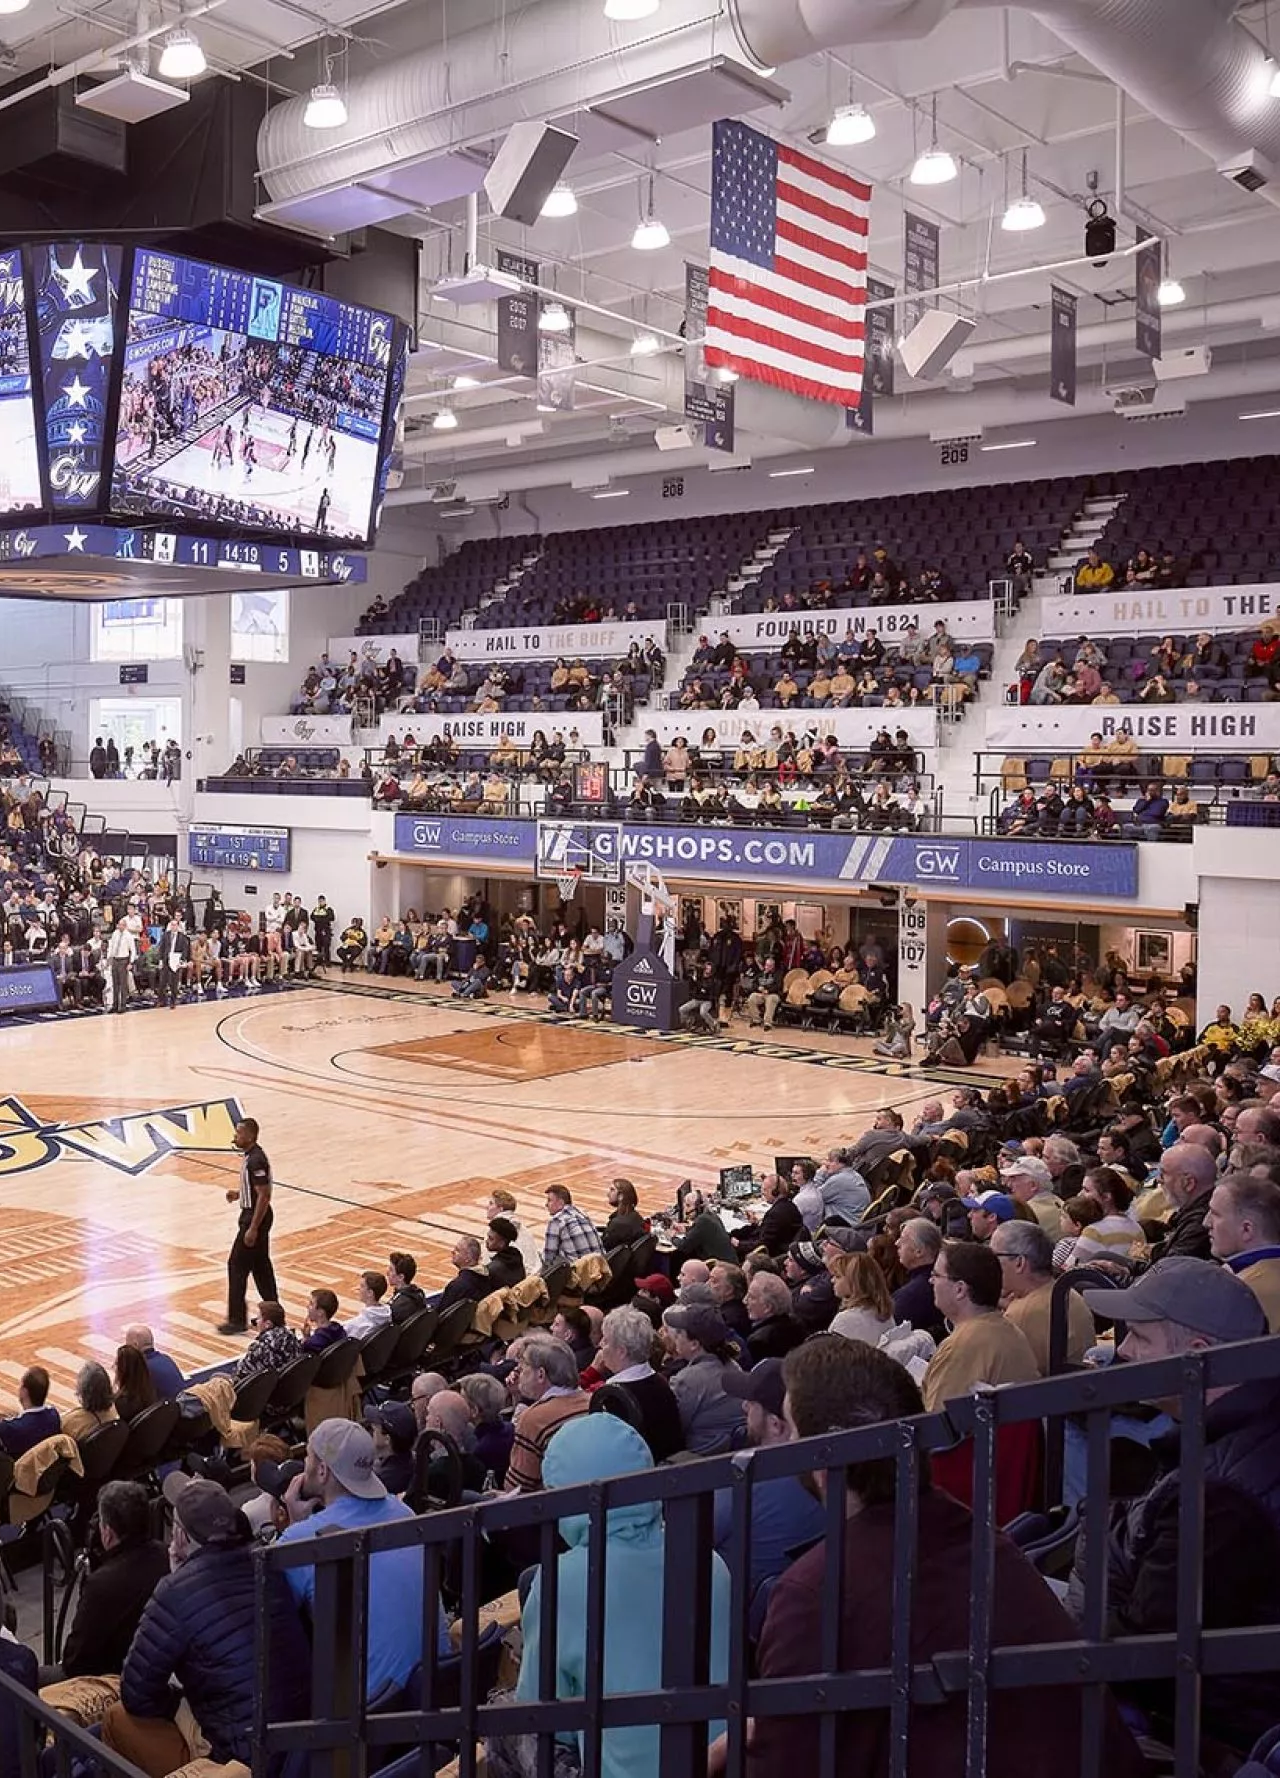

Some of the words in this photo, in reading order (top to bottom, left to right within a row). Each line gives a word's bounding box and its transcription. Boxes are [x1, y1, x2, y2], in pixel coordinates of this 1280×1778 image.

[941, 448, 968, 464] 209
[663, 484, 684, 497] 208
[161, 537, 169, 550] 4
[191, 542, 208, 564] 11
[225, 543, 258, 562] 14:19
[278, 552, 289, 572] 5
[307, 554, 313, 566] 1
[1114, 601, 1166, 620] HAIL
[1180, 598, 1210, 617] TO
[1224, 595, 1271, 615] THE
[756, 618, 837, 638] FOUNDED
[847, 616, 865, 634] IN
[877, 614, 920, 633] 1821
[486, 635, 517, 651] HAIL
[523, 634, 540, 650] TO
[547, 633, 574, 648] THE
[581, 630, 616, 647] BUFF
[490, 721, 526, 737] HIGH
[1102, 716, 1177, 736] RAISE
[1191, 715, 1256, 736] HIGH
[230, 837, 246, 848] 1ST
[414, 825, 441, 845] GW
[452, 829, 491, 844] Campus
[493, 830, 520, 846] Store
[595, 828, 816, 867] GWSHOPS.COM
[267, 853, 274, 868] 5
[915, 851, 958, 874] GW
[978, 857, 1043, 874] Campus
[1045, 860, 1090, 877] Store
[901, 914, 926, 929] 108
[901, 946, 926, 962] 107
[9, 984, 33, 997] Store
[627, 984, 657, 1004] GW
